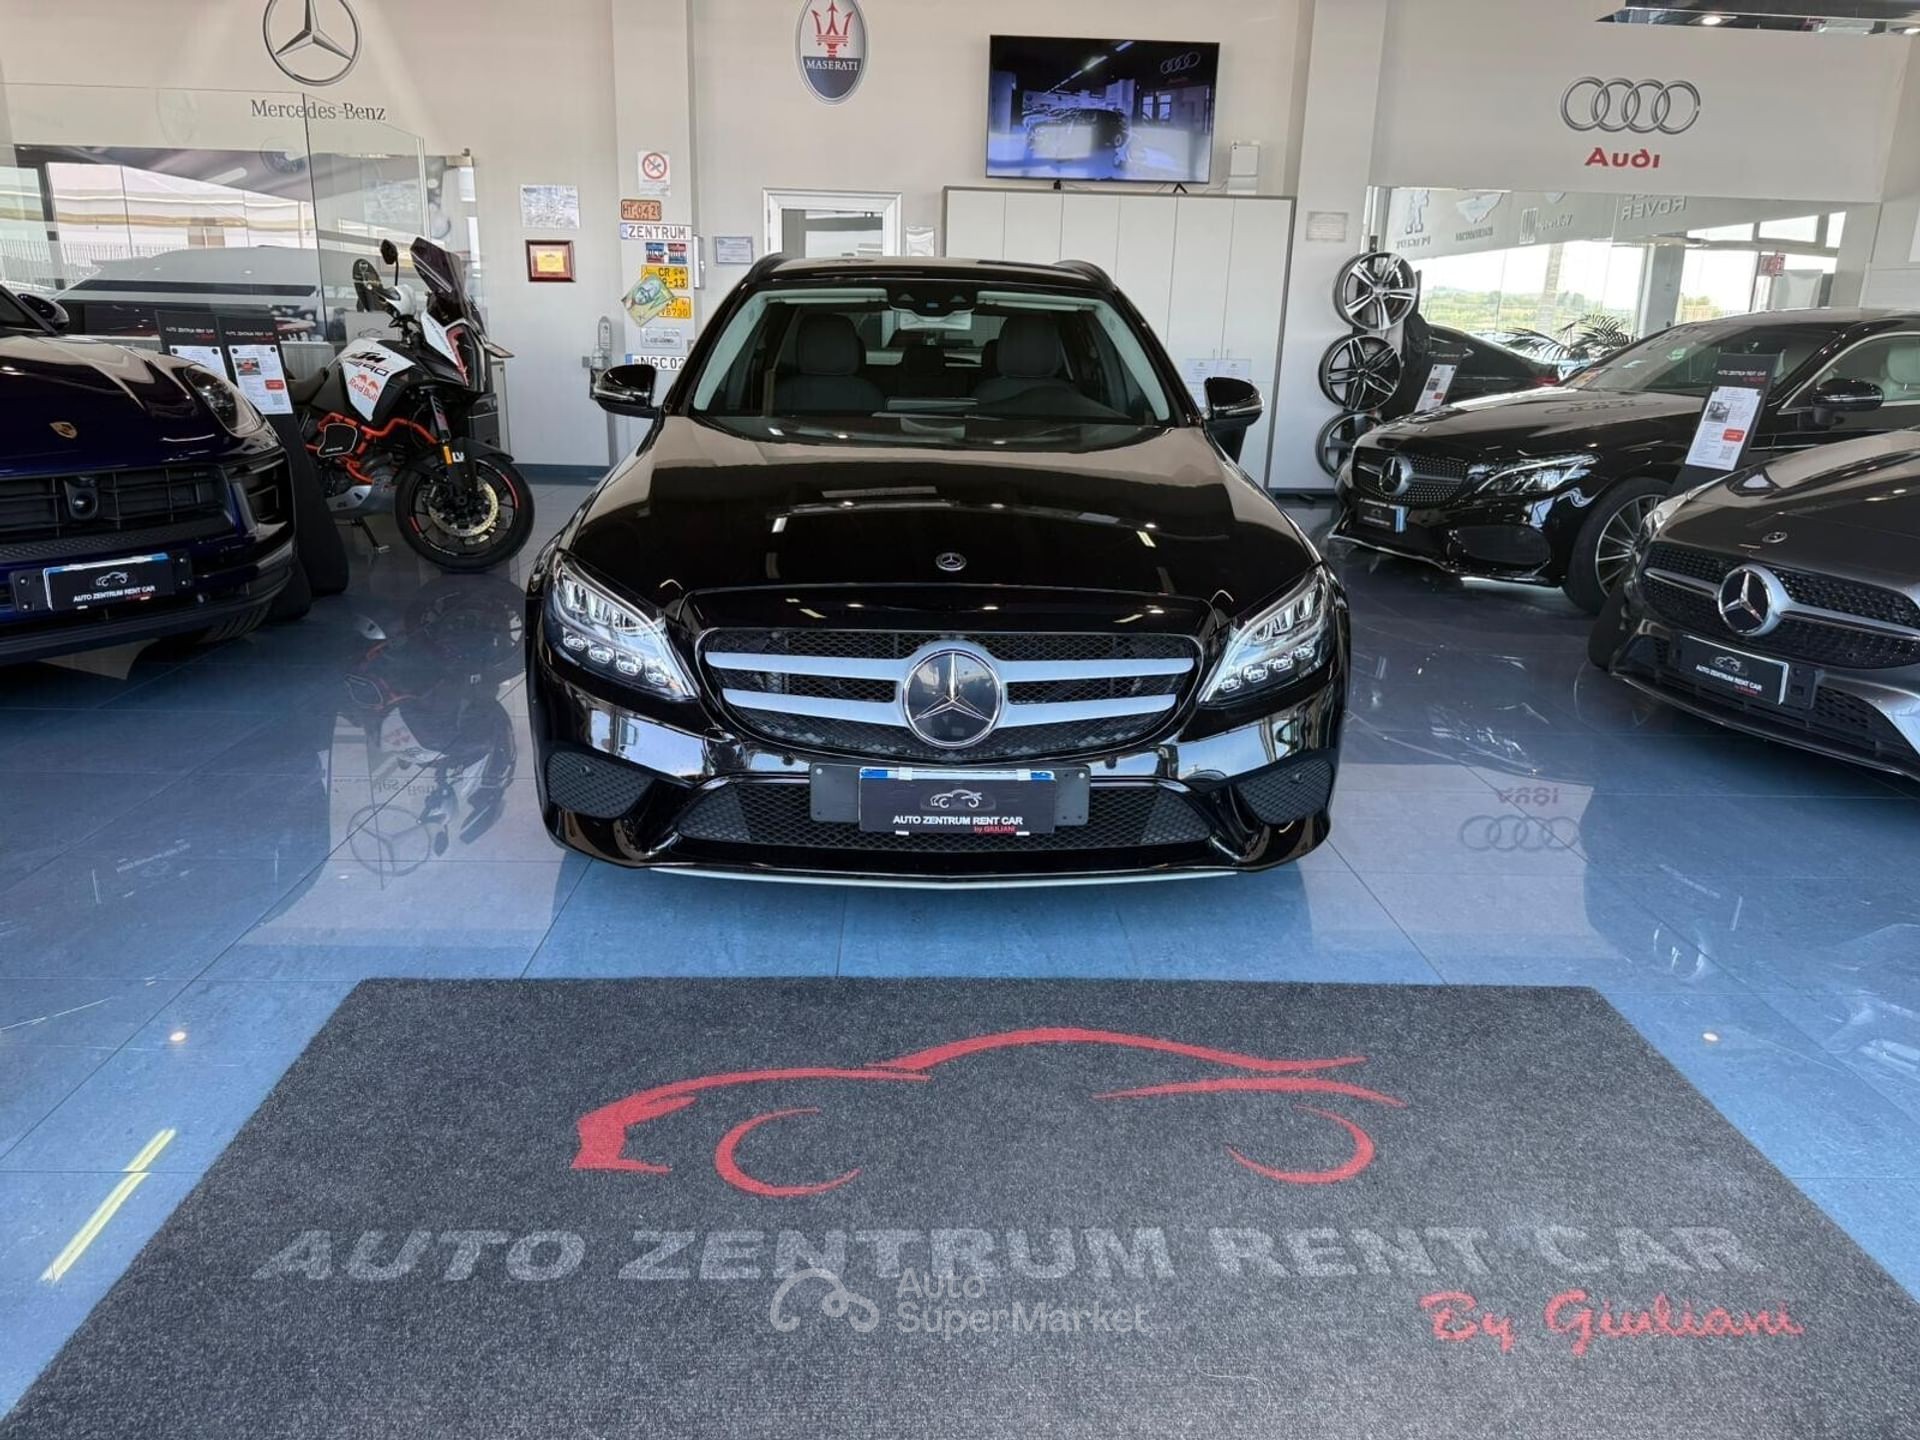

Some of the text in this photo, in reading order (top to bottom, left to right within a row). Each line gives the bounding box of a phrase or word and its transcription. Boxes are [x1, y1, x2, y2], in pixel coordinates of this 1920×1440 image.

[806, 60, 858, 71] MASERATI
[250, 98, 386, 121] Mercedes-Benz
[1583, 146, 1661, 169] Audi
[628, 225, 687, 239] ZENTRUM
[892, 815, 1024, 825] AUTO ZENTRUM RENT CAR
[252, 1225, 1762, 1281] AUTO ZENTRUM RENT CAR
[1419, 1287, 1805, 1356] By Giuliani
